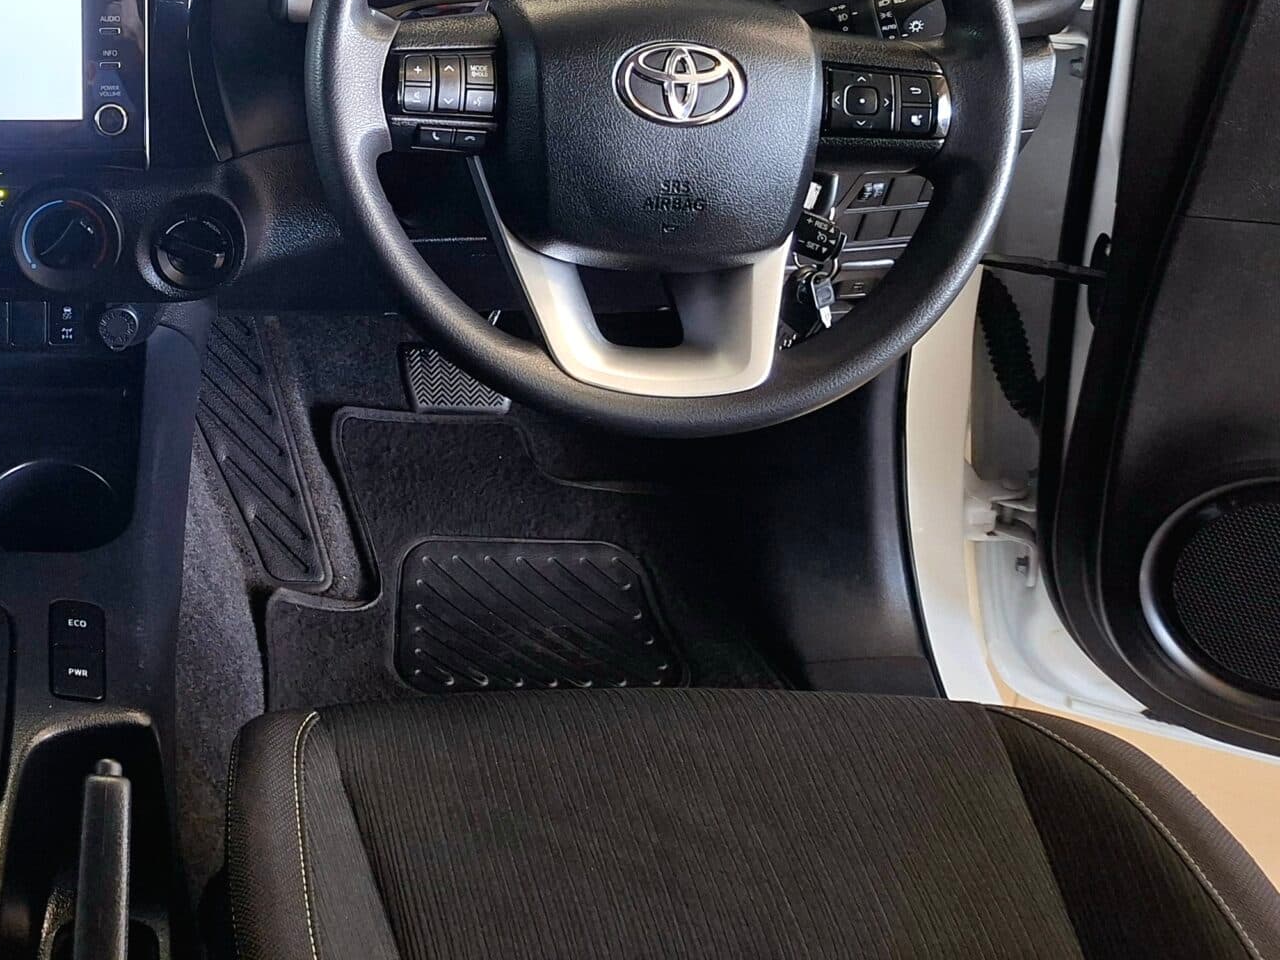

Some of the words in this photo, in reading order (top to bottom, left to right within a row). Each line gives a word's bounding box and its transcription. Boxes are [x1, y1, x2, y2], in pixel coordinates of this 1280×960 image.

[660, 180, 691, 193] SRS
[642, 196, 705, 211] AIRBAG
[806, 241, 821, 251] SET
[67, 618, 87, 628] ECO
[68, 667, 88, 678] PWR
